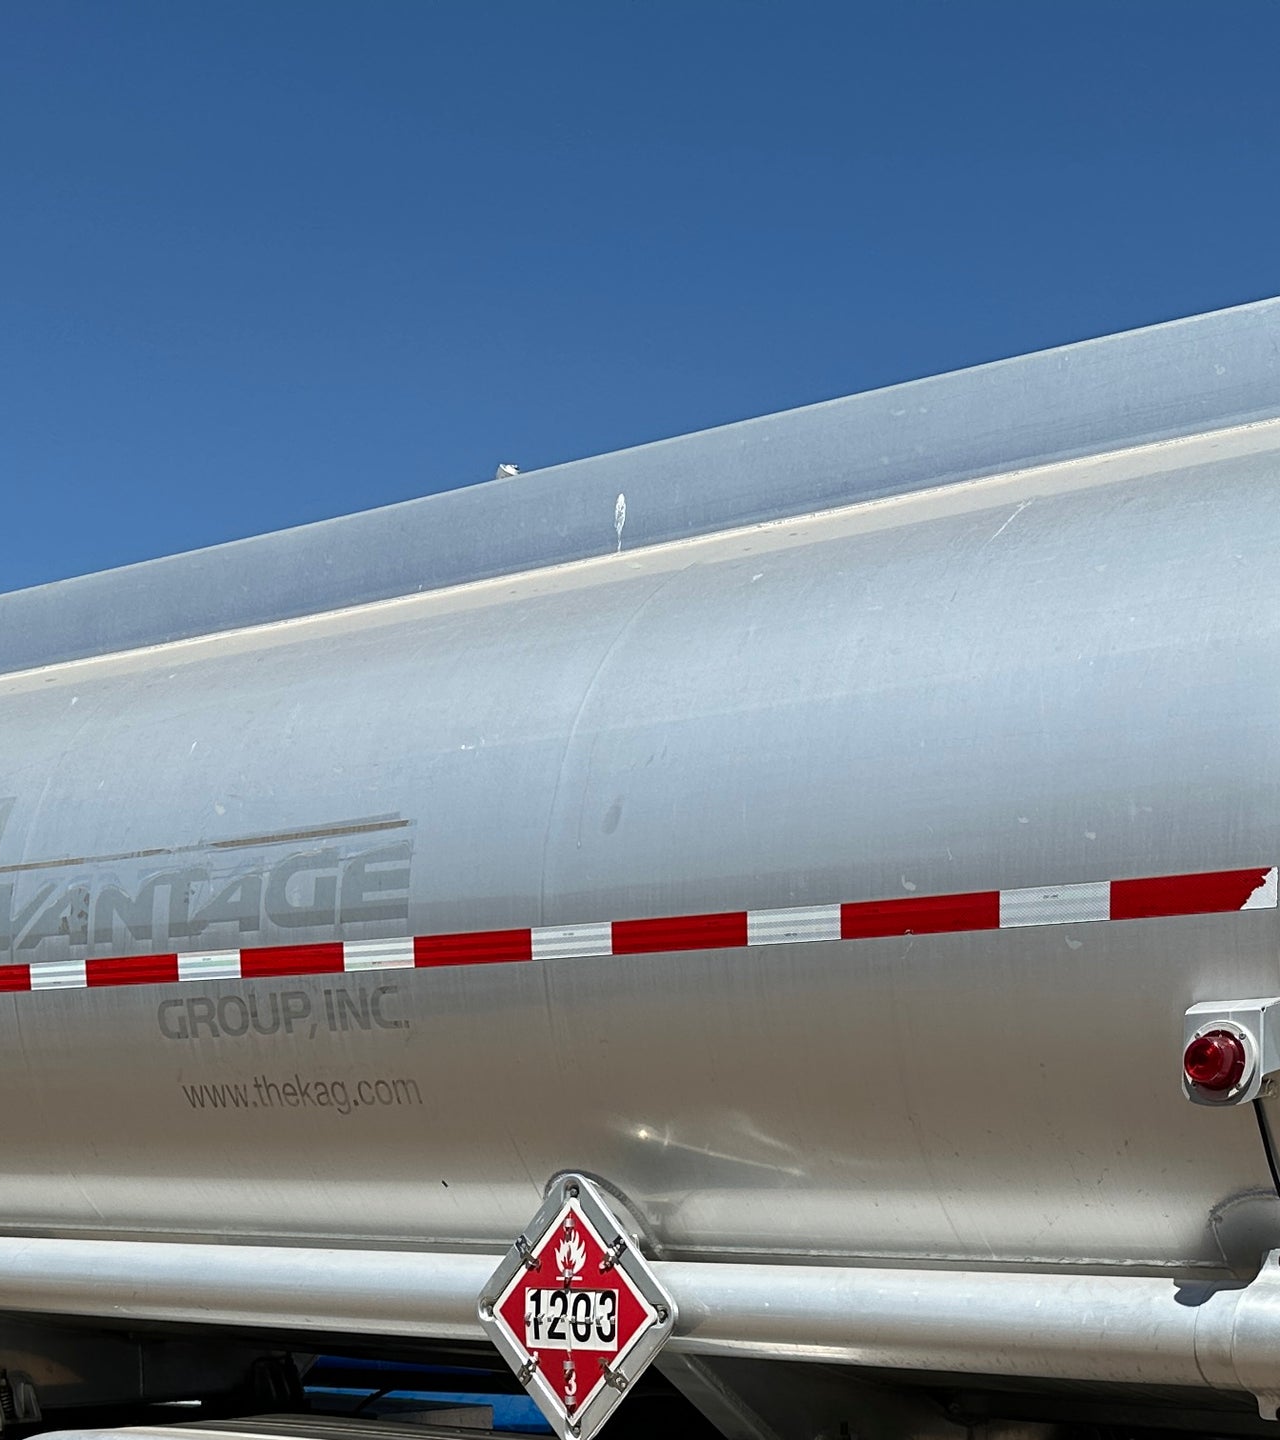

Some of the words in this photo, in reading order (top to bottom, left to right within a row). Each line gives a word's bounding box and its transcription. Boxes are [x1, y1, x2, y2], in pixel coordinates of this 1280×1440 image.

[157, 989, 318, 1040] GROUP,
[323, 985, 410, 1032] INC.
[182, 1074, 423, 1115] www.thekag.com
[529, 1289, 617, 1343] 1203
[564, 1369, 577, 1396] 3
